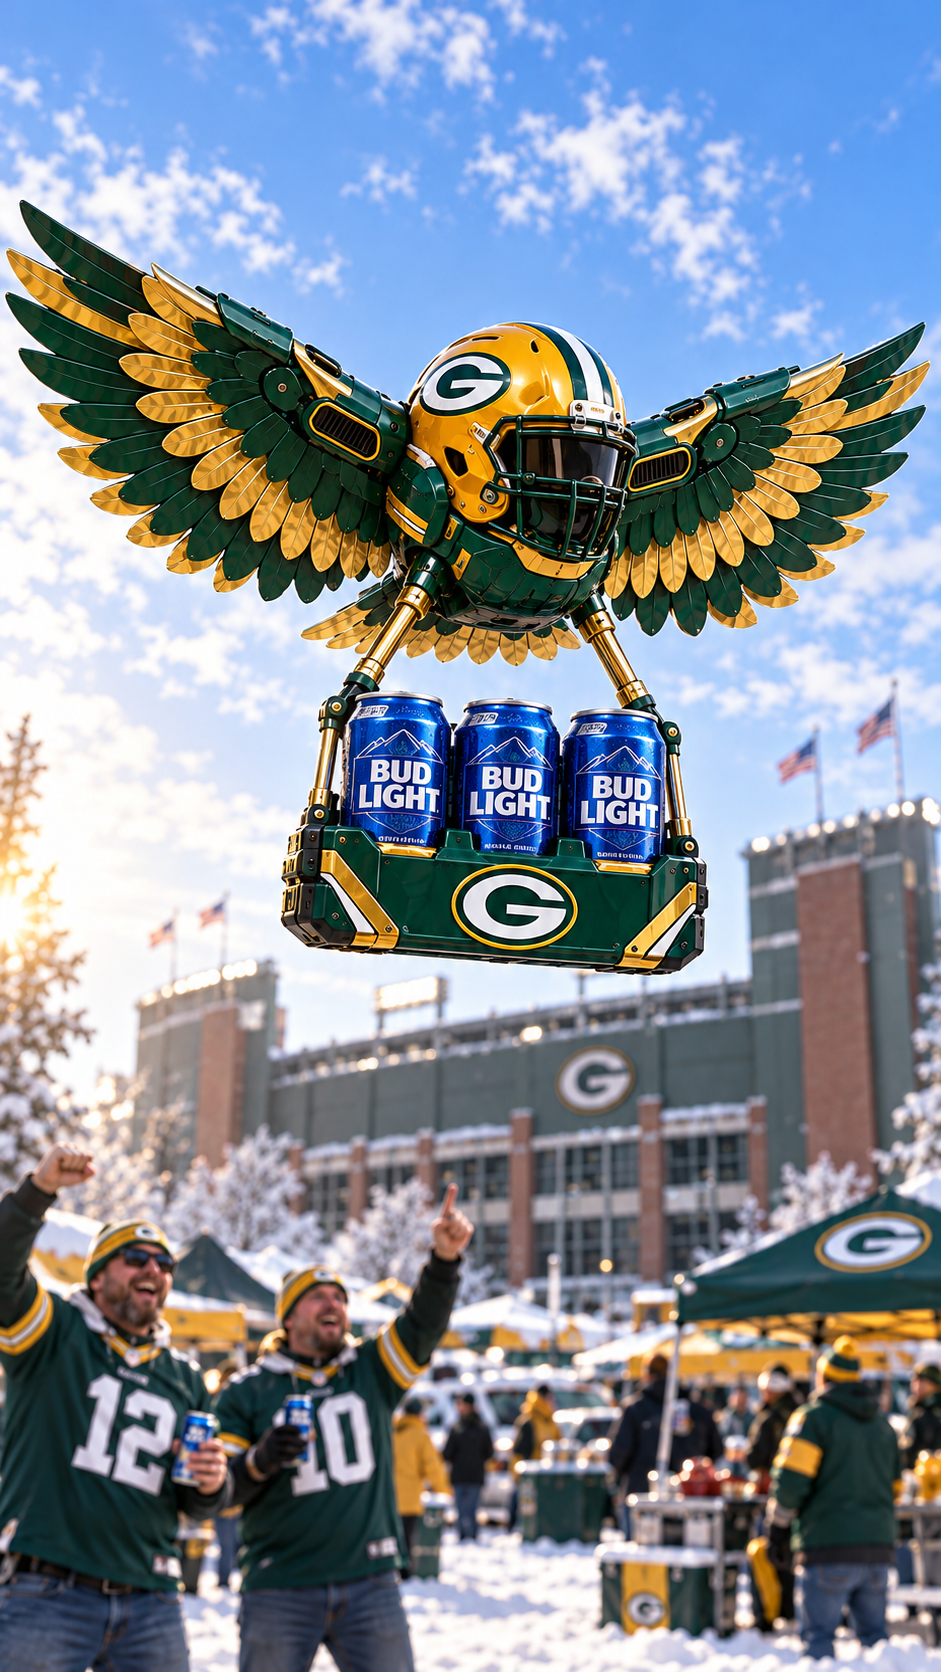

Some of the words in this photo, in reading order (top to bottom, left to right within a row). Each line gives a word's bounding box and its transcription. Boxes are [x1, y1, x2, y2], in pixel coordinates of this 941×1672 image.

[422, 355, 504, 411] G
[370, 759, 432, 785] BUD
[482, 766, 543, 793] BUD
[592, 775, 652, 802] BUD
[358, 784, 440, 813] LIGHT
[469, 791, 551, 820] LIGHT
[580, 800, 659, 827] LIGHT
[463, 873, 567, 940] G
[559, 1049, 632, 1111] G
[823, 1216, 924, 1268] G
[71, 1373, 177, 1497] 12
[273, 1391, 376, 1497] 10
